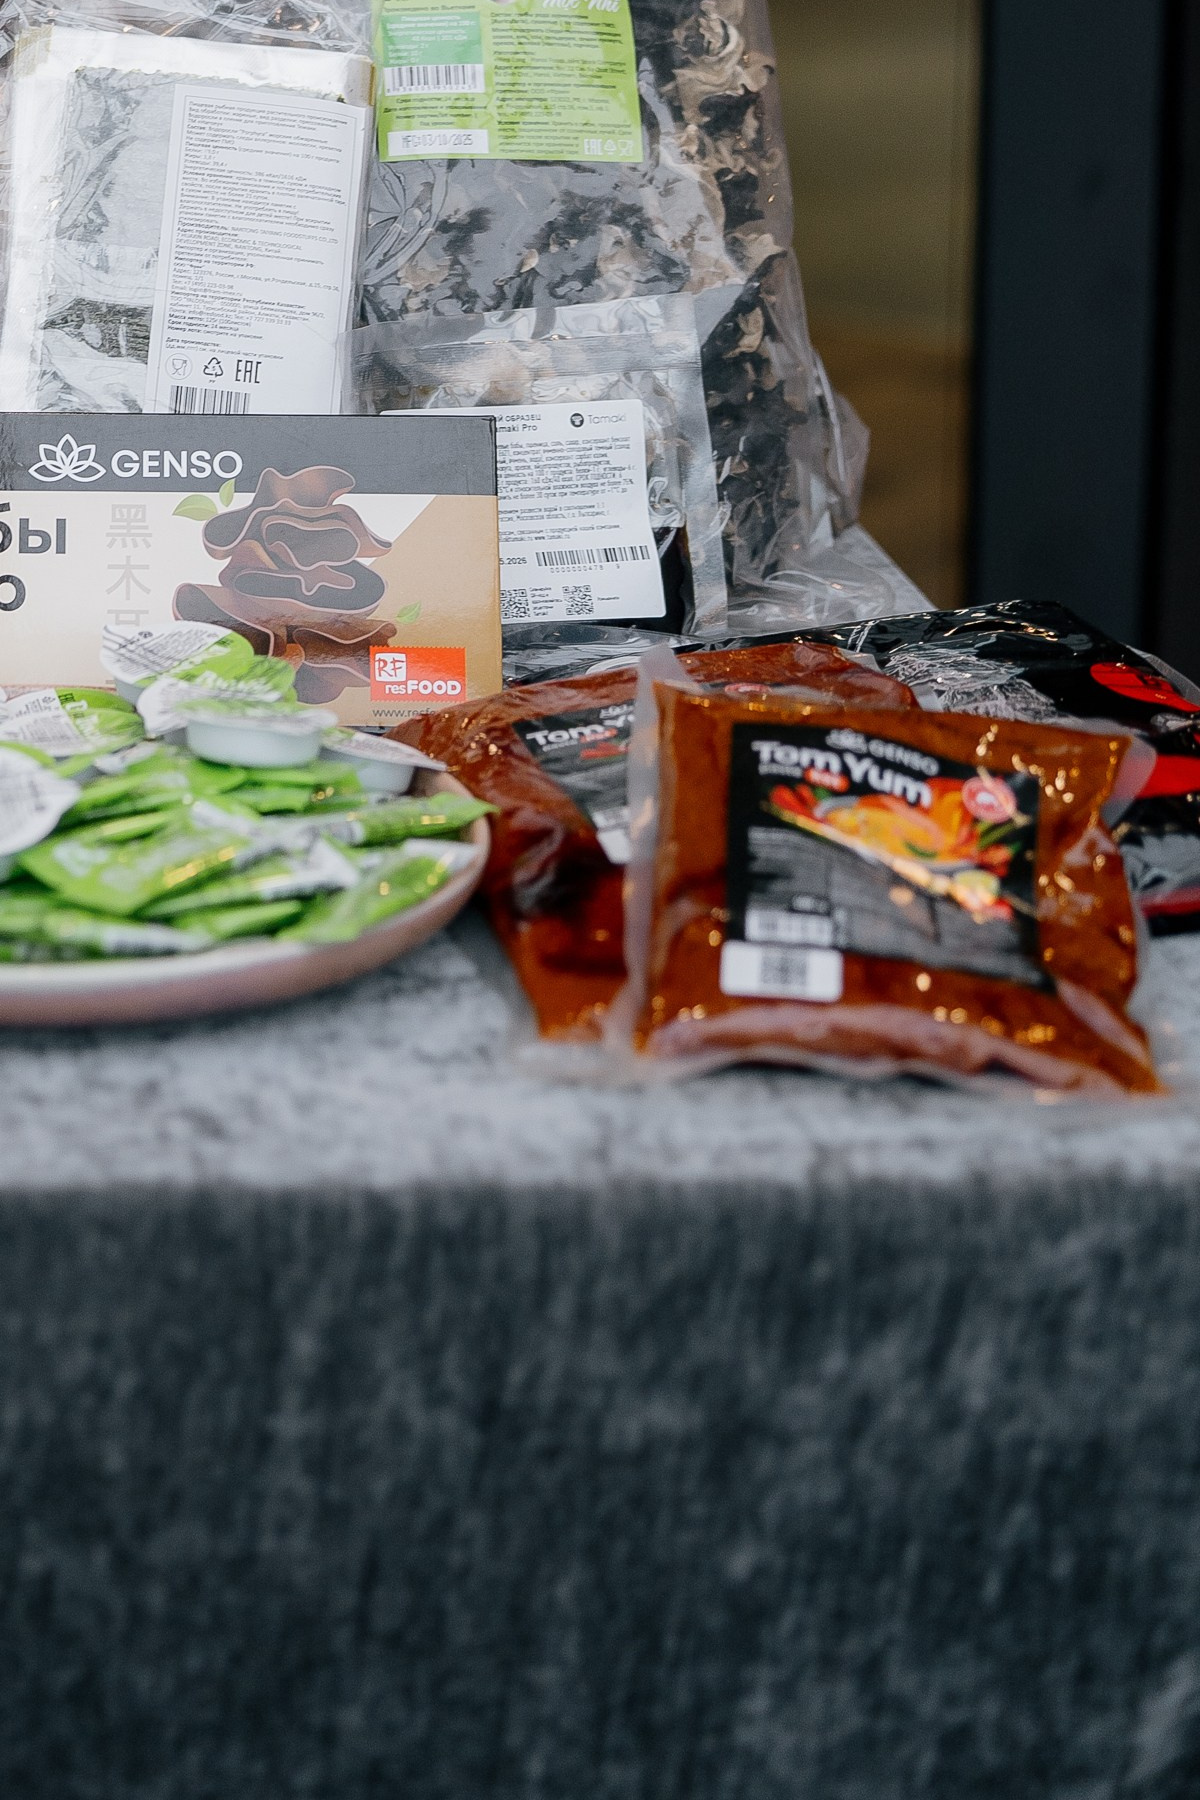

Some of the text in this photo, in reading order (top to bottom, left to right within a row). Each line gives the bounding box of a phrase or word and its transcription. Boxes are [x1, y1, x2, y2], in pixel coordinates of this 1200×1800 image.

[505, 414, 541, 422] ОБРАЗЕЦ
[588, 414, 626, 424] Tamaki
[496, 423, 537, 432] amaki Pro
[111, 450, 243, 478] GENSO
[375, 657, 405, 677] RF
[385, 680, 461, 695] resFOOD
[526, 725, 605, 747] Tom
[751, 741, 842, 775] Tom
[843, 752, 933, 808] Yum
